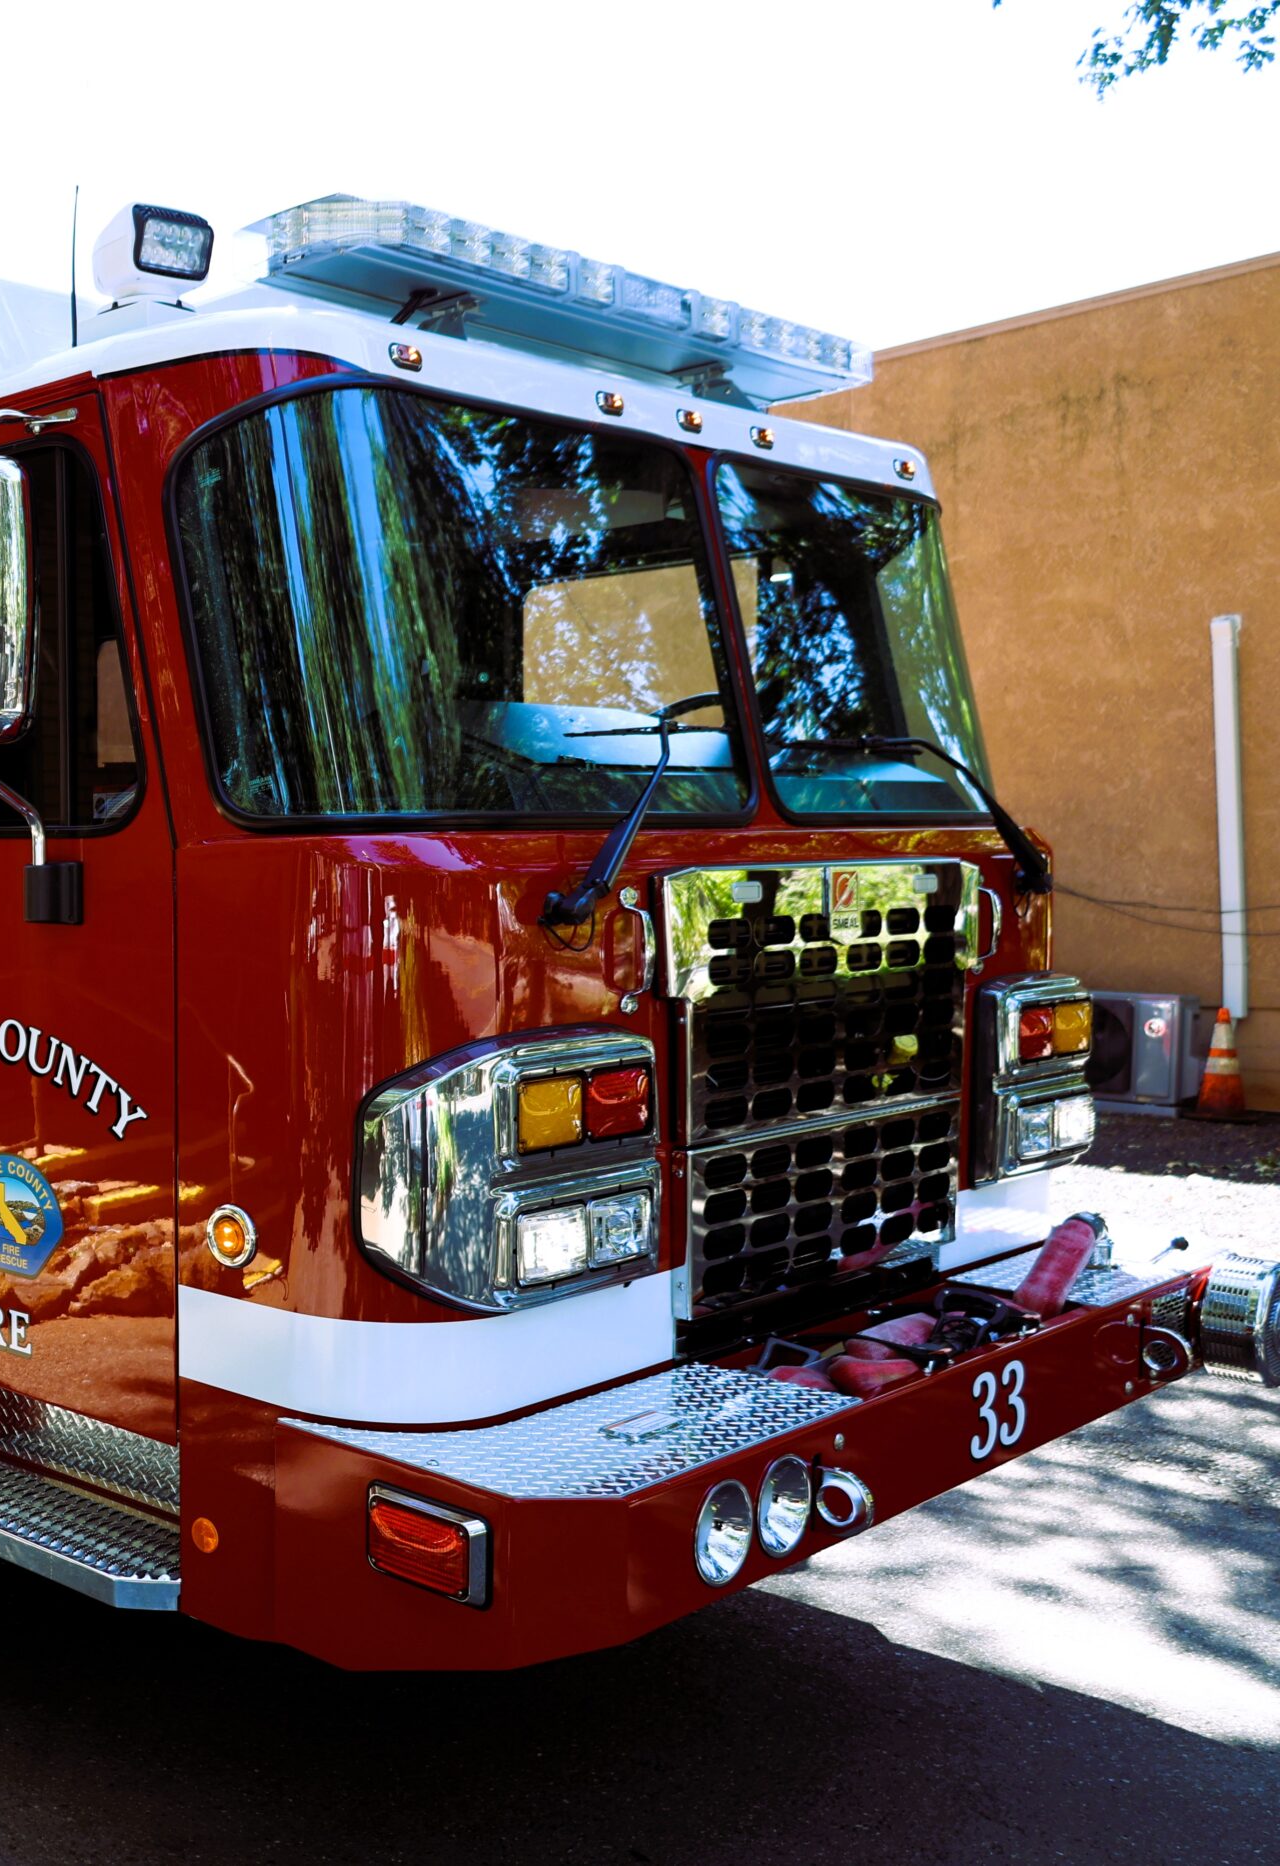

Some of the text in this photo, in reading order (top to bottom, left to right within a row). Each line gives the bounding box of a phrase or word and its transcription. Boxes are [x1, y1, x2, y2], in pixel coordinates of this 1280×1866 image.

[832, 916, 860, 929] SMEAL
[7, 1161, 54, 1210] COUNTY
[2, 1243, 21, 1256] FIRE
[969, 1359, 1027, 1460] 33
